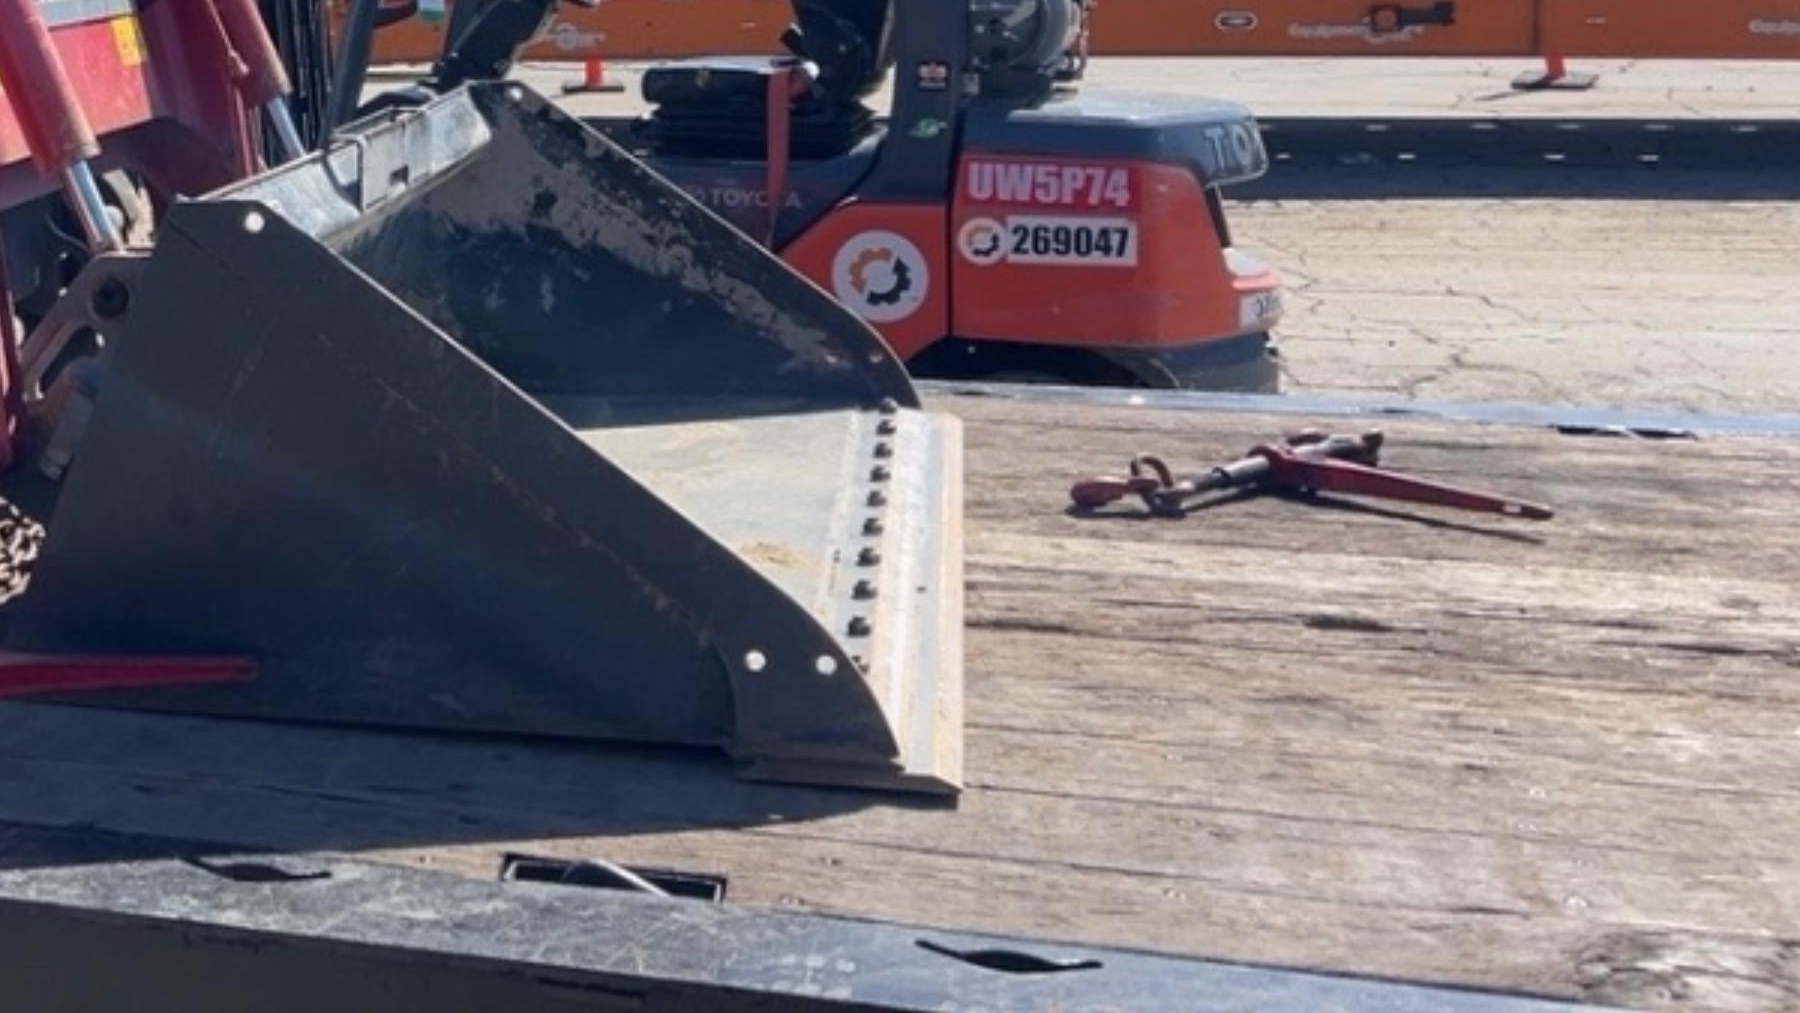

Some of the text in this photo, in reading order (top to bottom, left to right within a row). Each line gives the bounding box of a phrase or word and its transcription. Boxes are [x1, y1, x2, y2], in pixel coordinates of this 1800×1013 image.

[712, 190, 802, 207] TOYOA
[967, 163, 1131, 208] UW5P74
[1010, 222, 1129, 260] 269047
